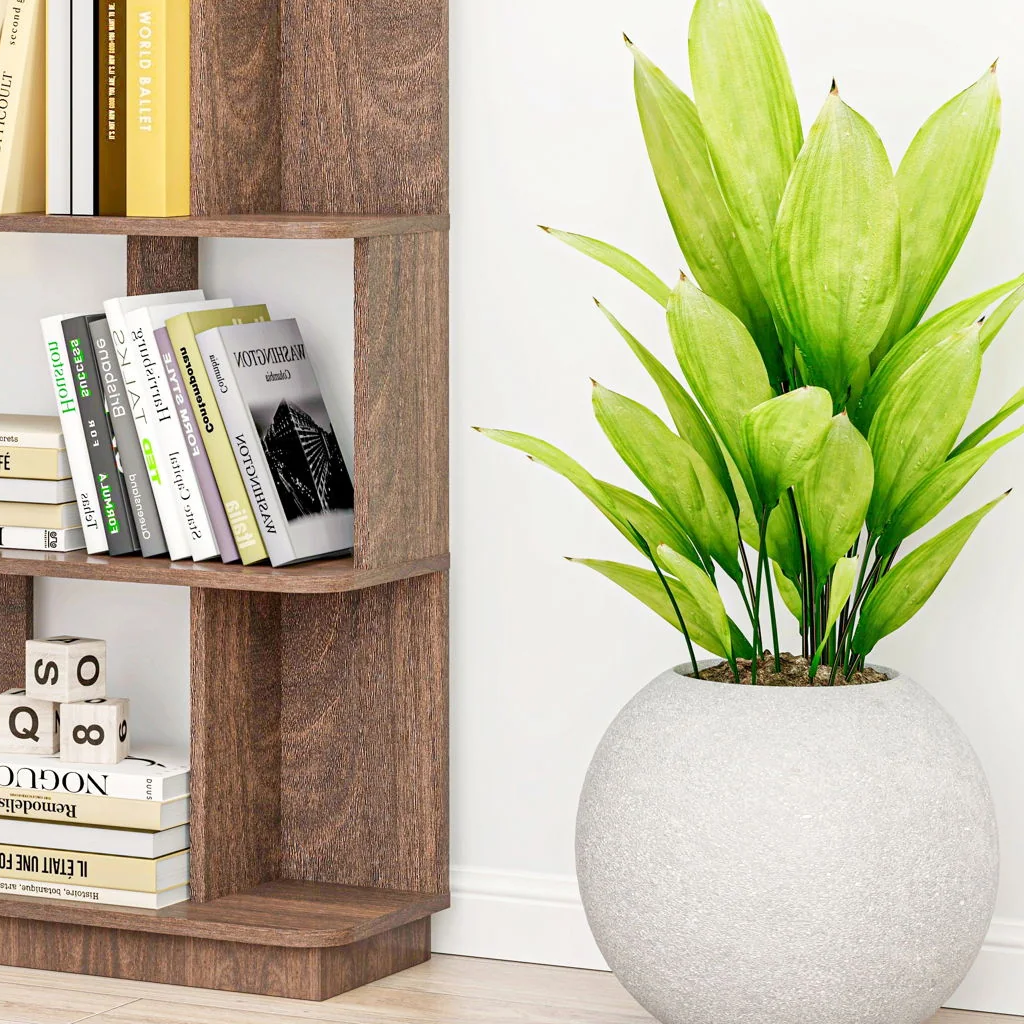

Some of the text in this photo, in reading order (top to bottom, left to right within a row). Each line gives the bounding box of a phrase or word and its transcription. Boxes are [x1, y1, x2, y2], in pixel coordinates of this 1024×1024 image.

[9, 6, 21, 45] second
[138, 11, 152, 132] WORLD BALLET
[34, 658, 59, 686] S
[8, 706, 39, 742] Q
[72, 724, 105, 746] 8
[16, 854, 39, 873] UNE
[43, 856, 74, 880] ÉTAIT
[77, 860, 88, 878] IL
[0, 881, 18, 890] arts
[19, 885, 61, 896] botanique,
[63, 890, 99, 900] Histoire,
